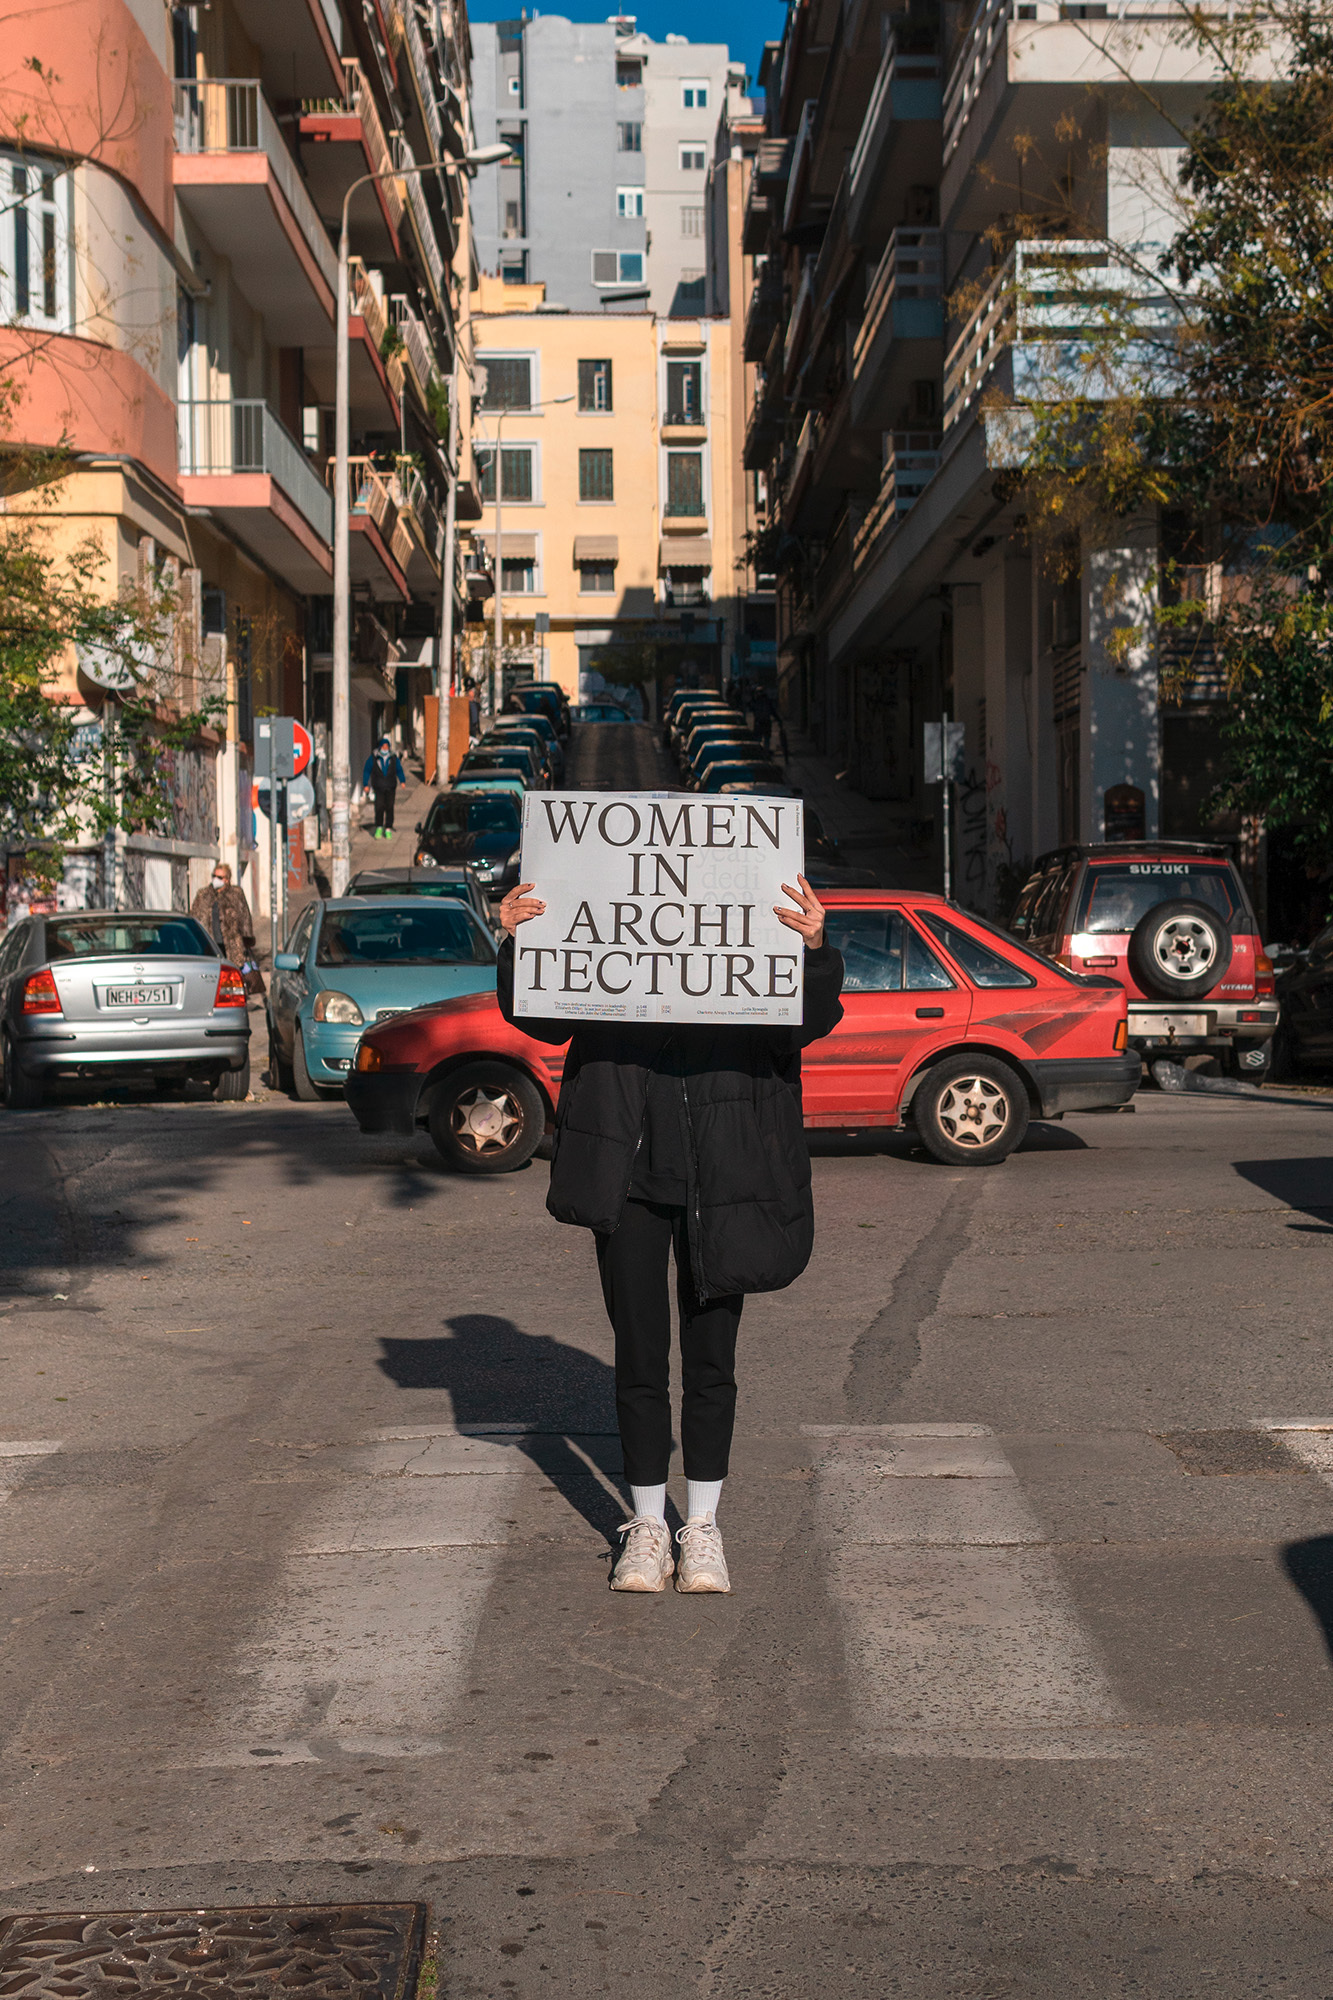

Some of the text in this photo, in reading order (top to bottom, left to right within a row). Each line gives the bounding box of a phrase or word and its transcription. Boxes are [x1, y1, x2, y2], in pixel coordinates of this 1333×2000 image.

[541, 800, 785, 850] WOMEN
[627, 853, 694, 898] IN
[1129, 864, 1190, 875] SUZUKI
[562, 901, 756, 948] ARCHI
[519, 946, 799, 998] TECTURE
